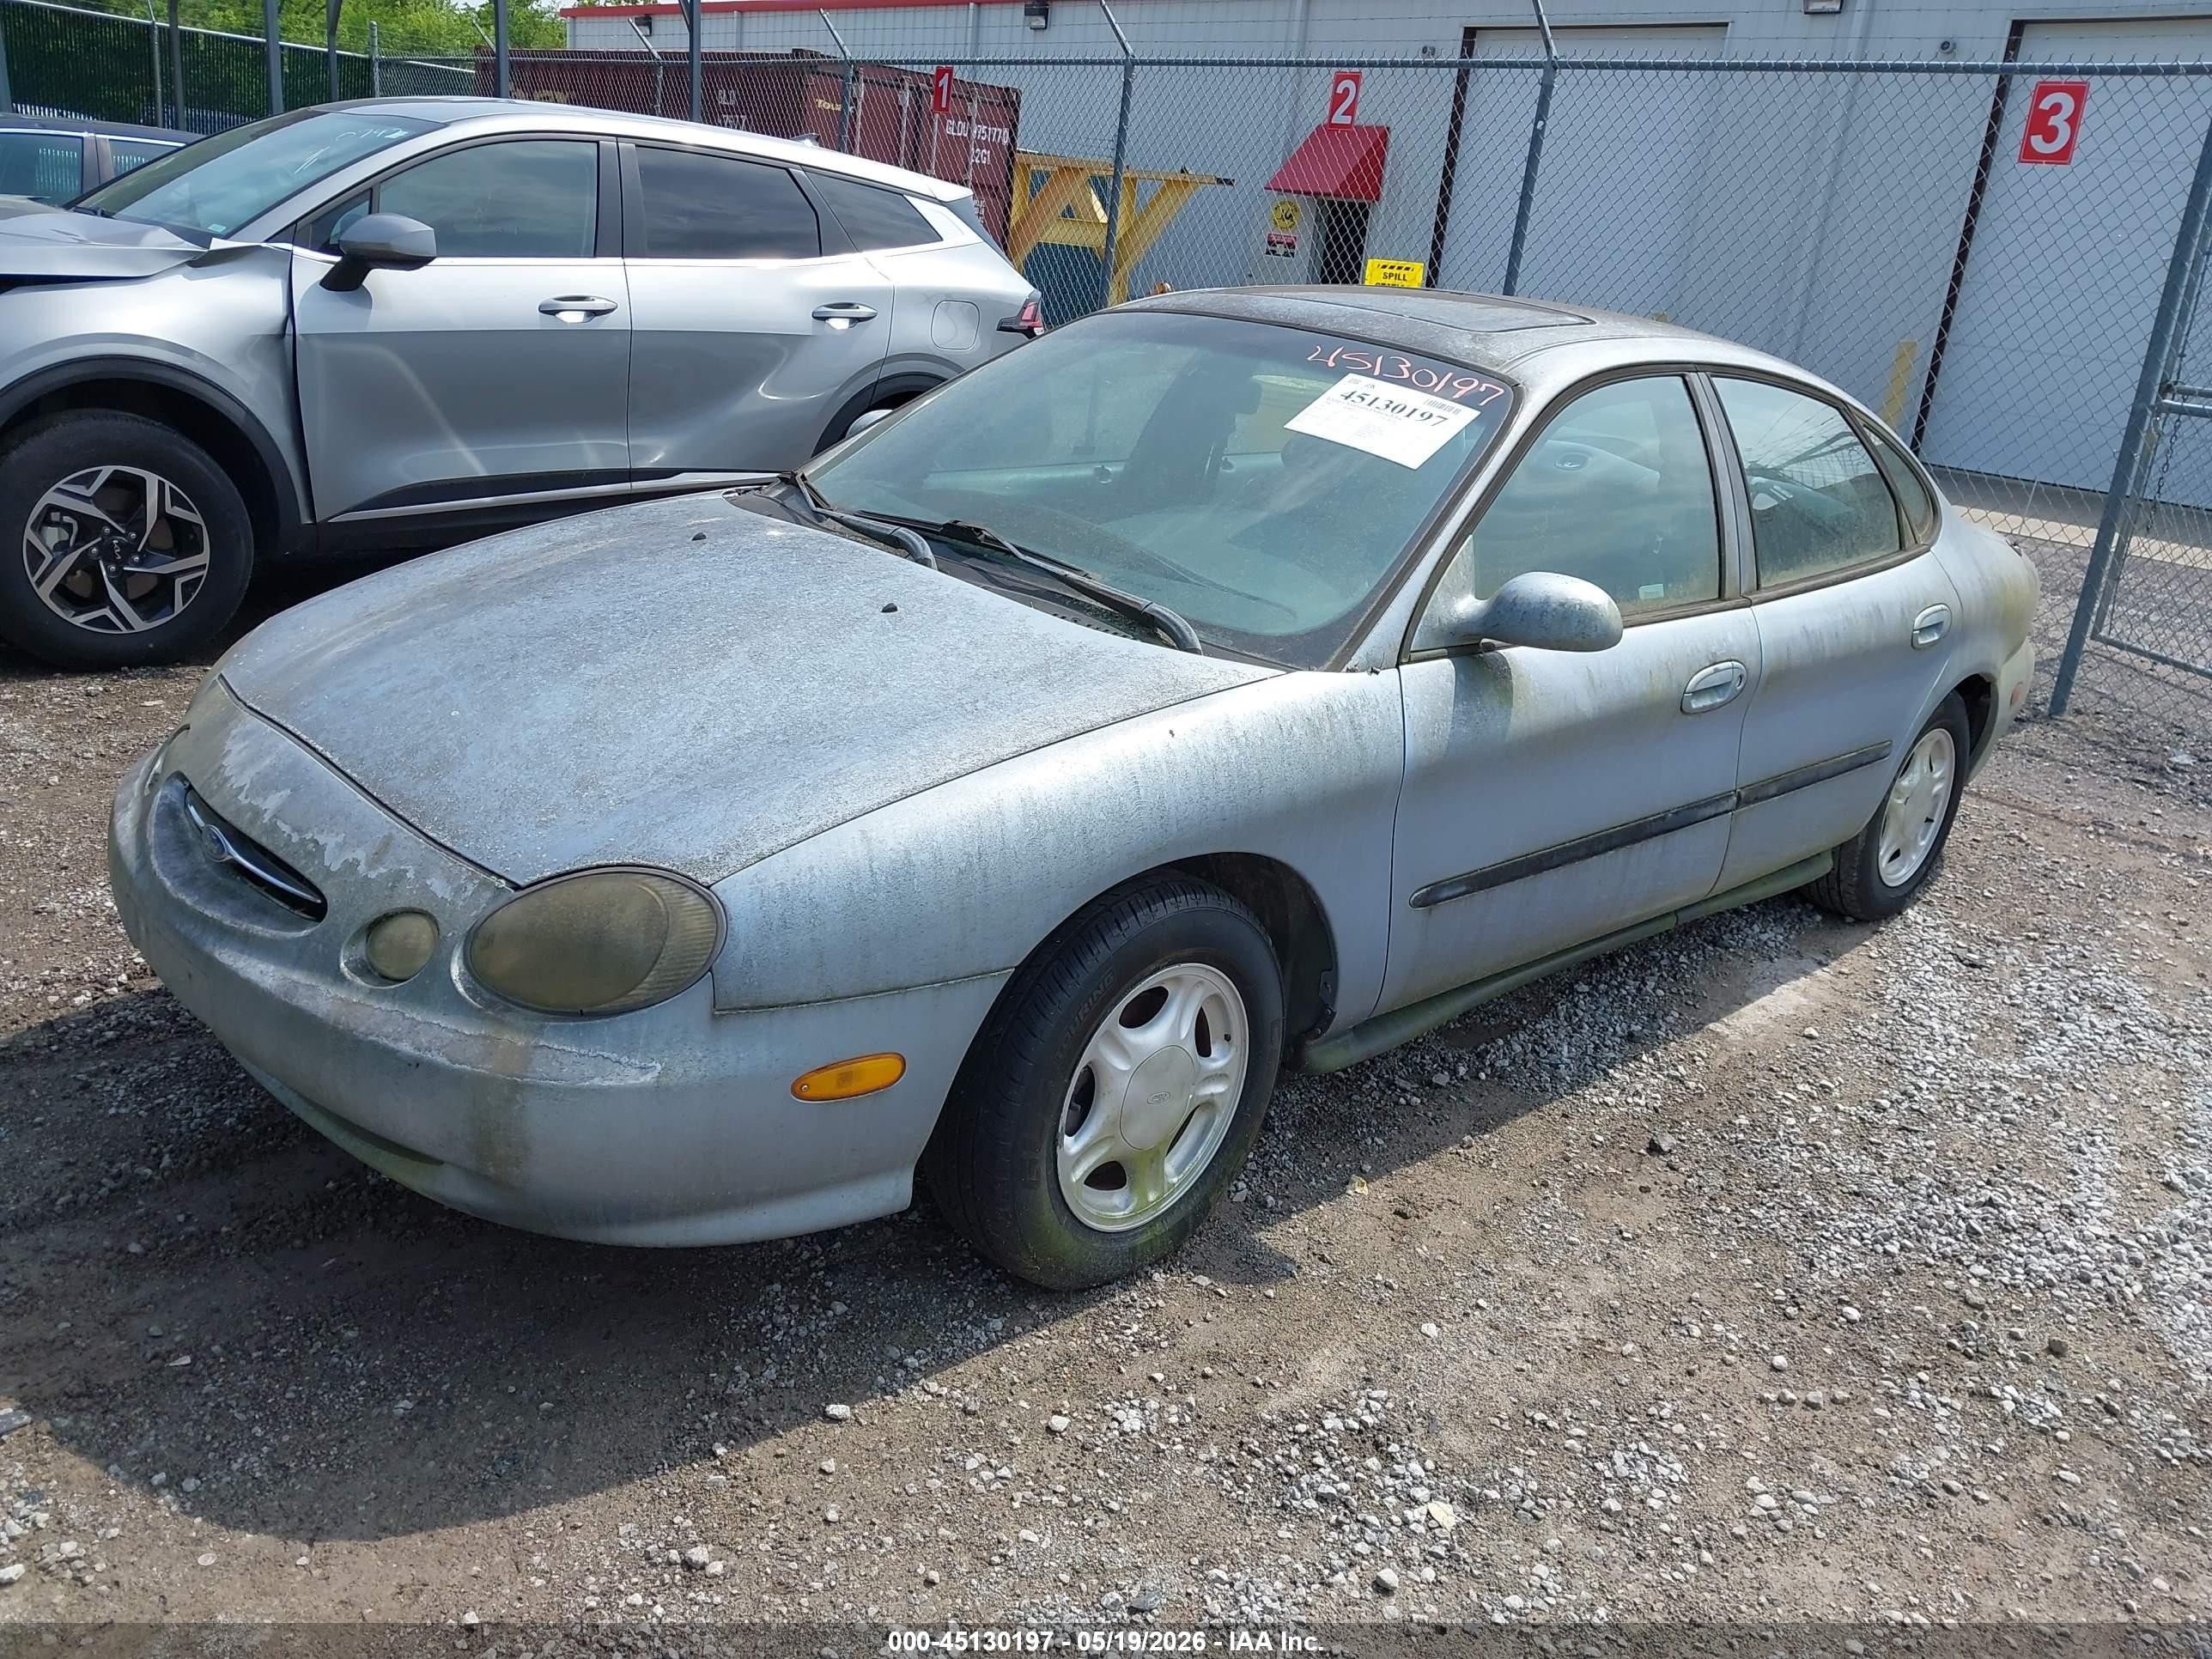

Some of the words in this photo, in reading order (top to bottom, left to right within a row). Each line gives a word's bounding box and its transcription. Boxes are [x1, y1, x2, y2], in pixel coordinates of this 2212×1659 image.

[938, 73, 950, 109] 1
[1331, 79, 1357, 125] 2
[2030, 92, 2075, 155] 3
[1382, 271, 1407, 282] SPILL
[1305, 345, 1505, 406] 45130197
[1340, 391, 1449, 427] 45130197
